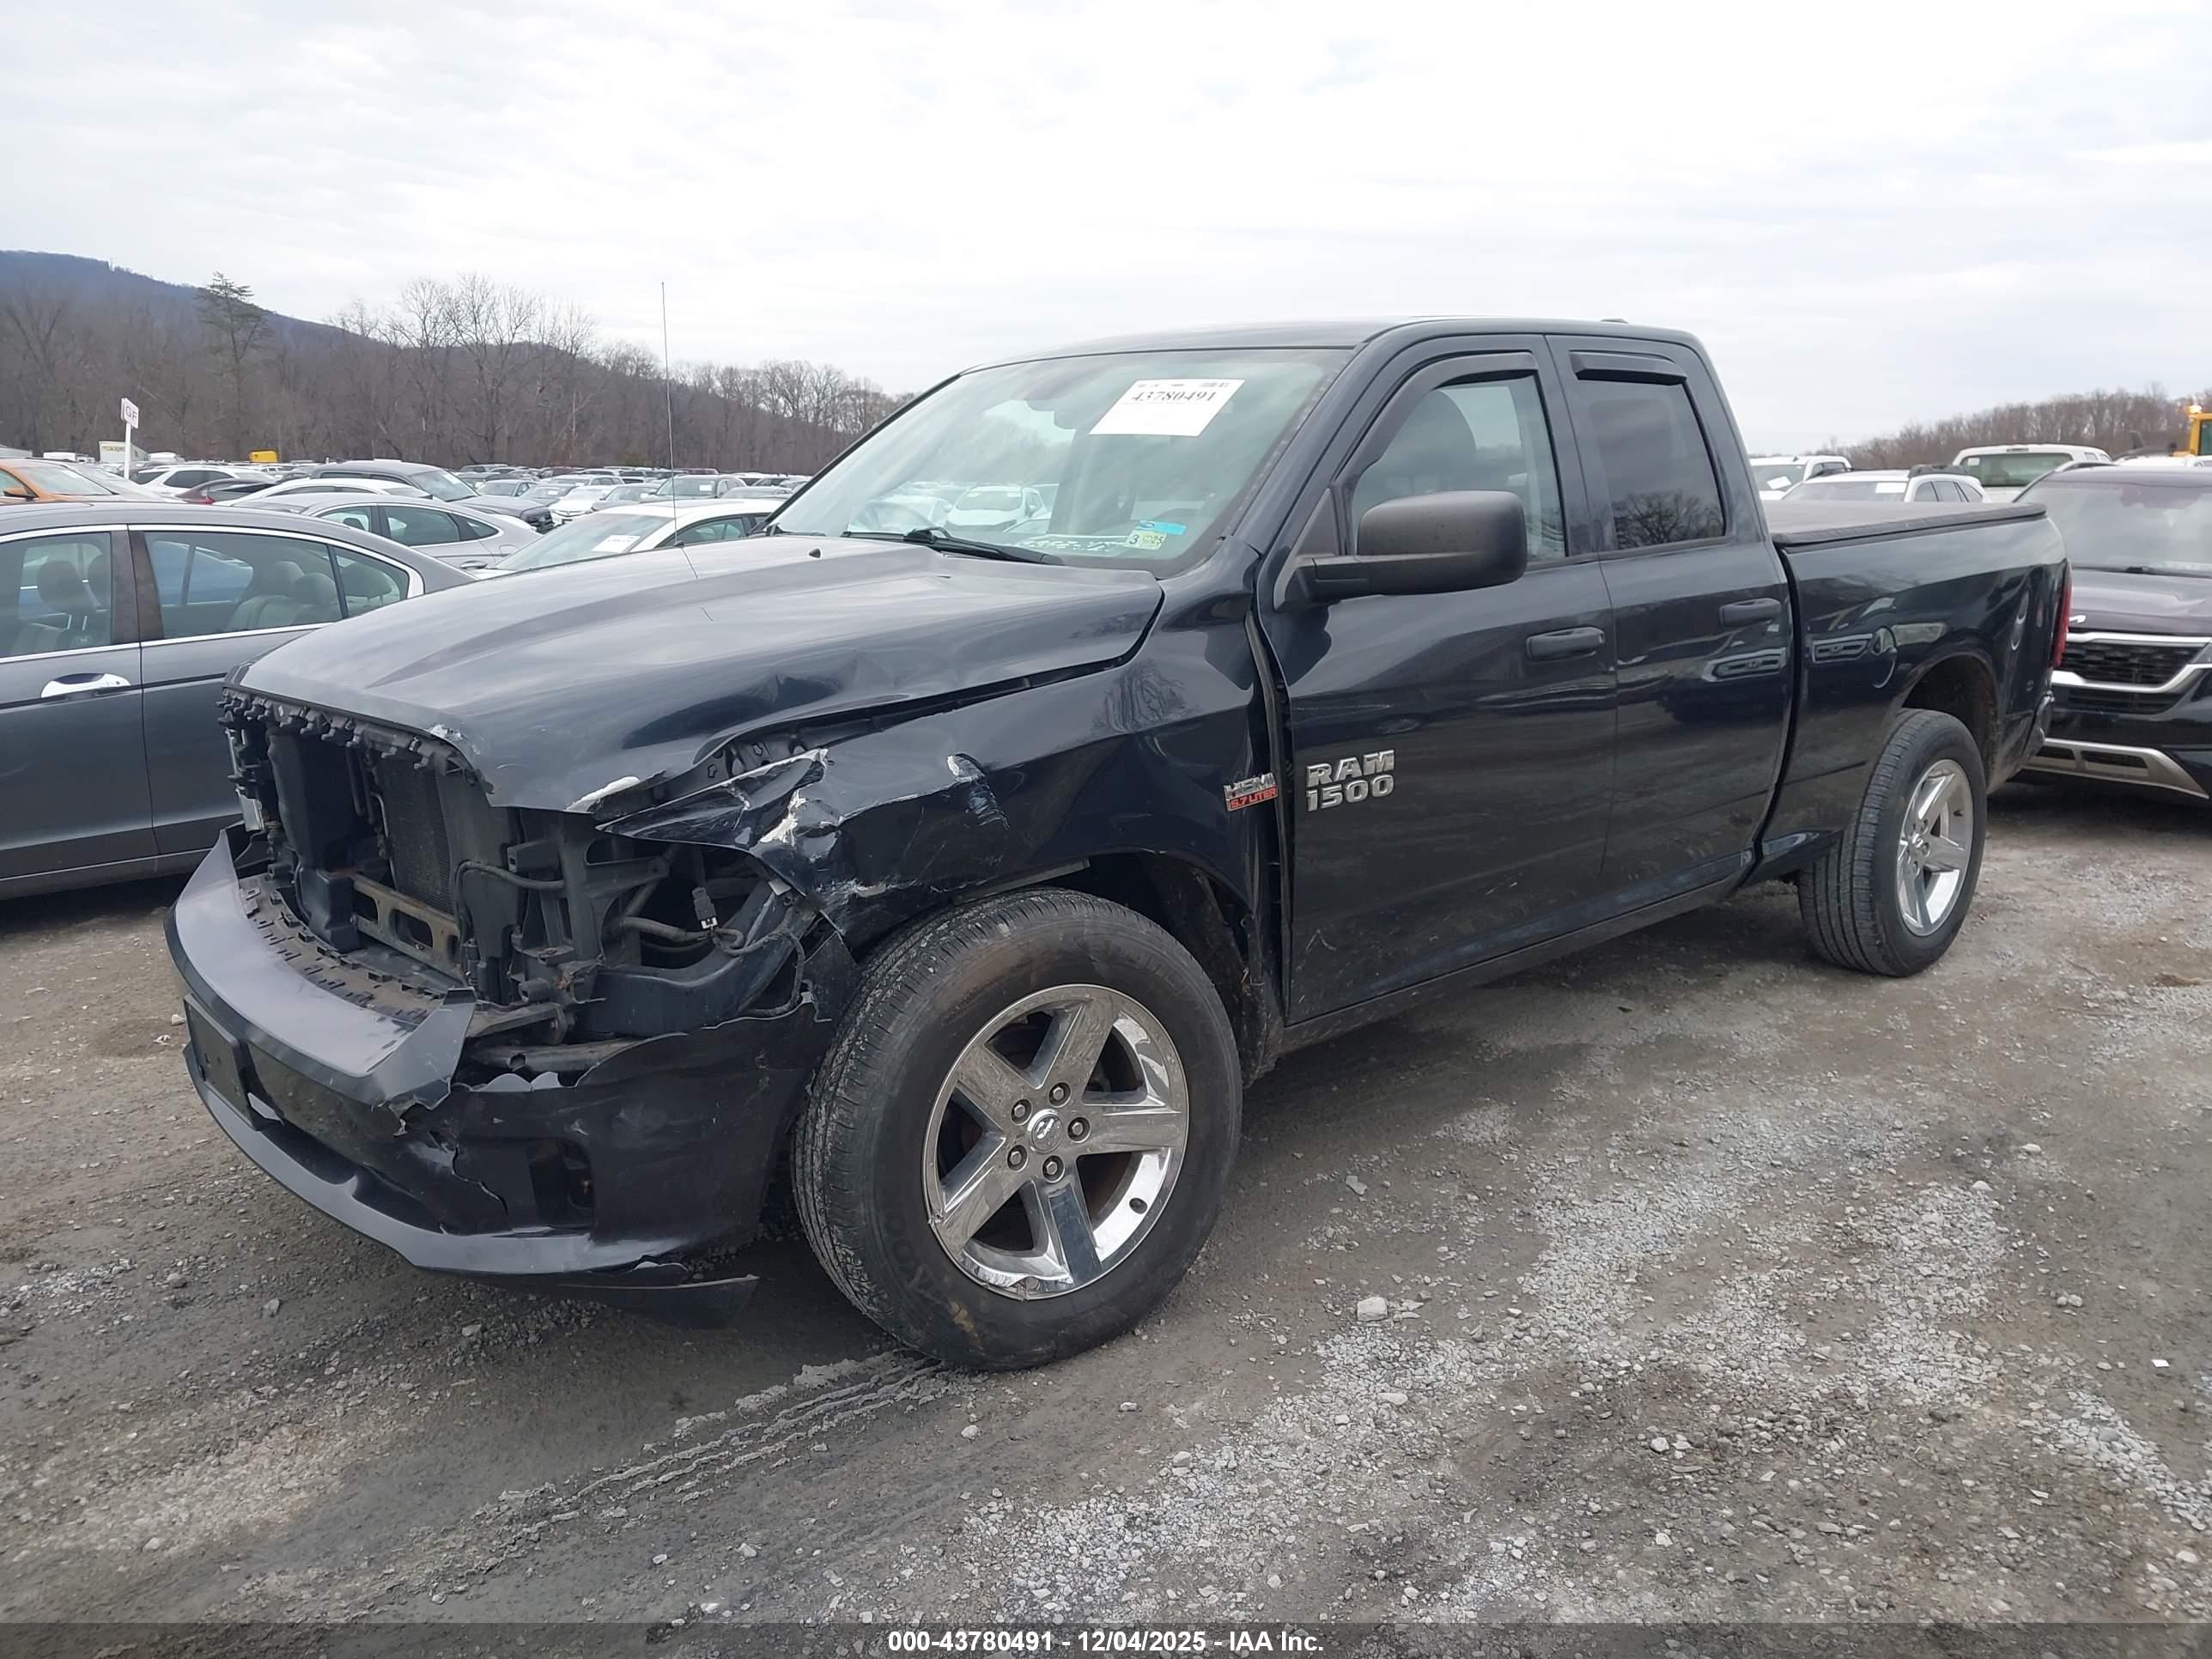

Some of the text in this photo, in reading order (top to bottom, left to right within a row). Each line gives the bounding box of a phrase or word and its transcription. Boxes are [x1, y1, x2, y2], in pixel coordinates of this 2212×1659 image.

[1130, 391, 1218, 402] 43780491
[1129, 534, 1139, 544] 3
[1306, 750, 1395, 787] RAM
[1230, 787, 1277, 809] 5.7 LITER
[1306, 774, 1395, 811] 1500
